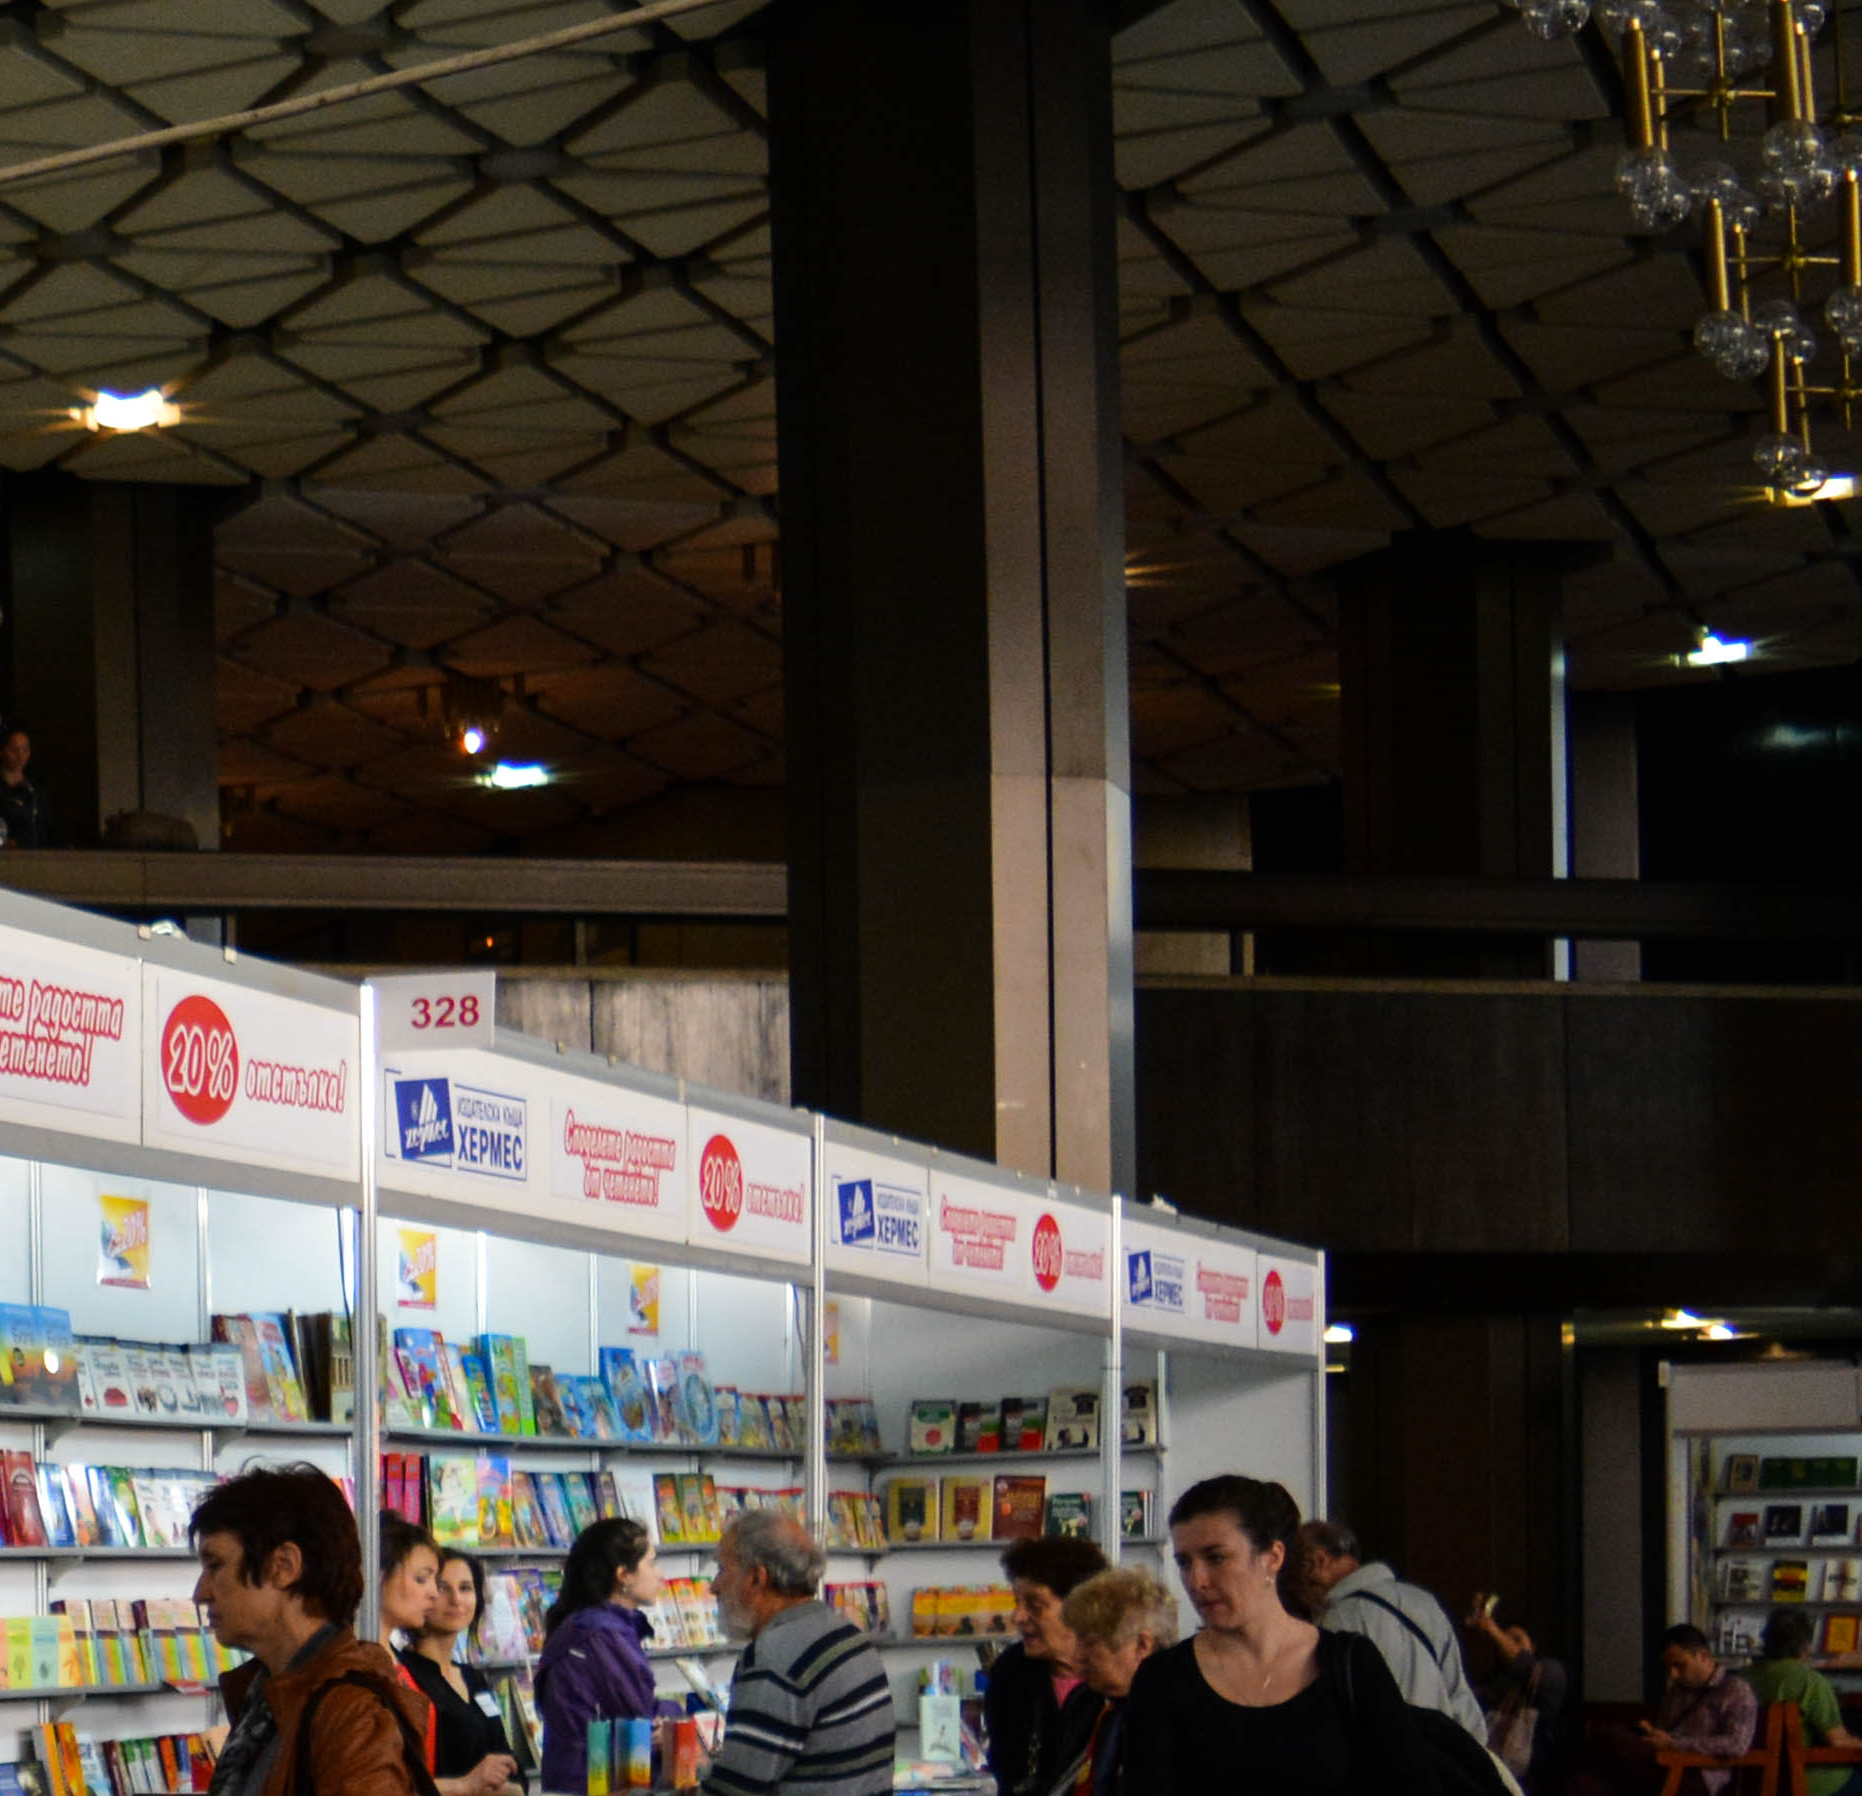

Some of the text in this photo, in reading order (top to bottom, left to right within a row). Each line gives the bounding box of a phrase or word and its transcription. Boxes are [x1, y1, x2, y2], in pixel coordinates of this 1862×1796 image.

[27, 979, 125, 1041] радостта
[412, 995, 480, 1029] 328
[167, 1023, 348, 1114] 20% отстъпка!
[458, 1124, 523, 1172] ХЕРМЕС
[703, 1155, 742, 1214] 20%
[877, 1214, 919, 1248] ХЕРМЕС
